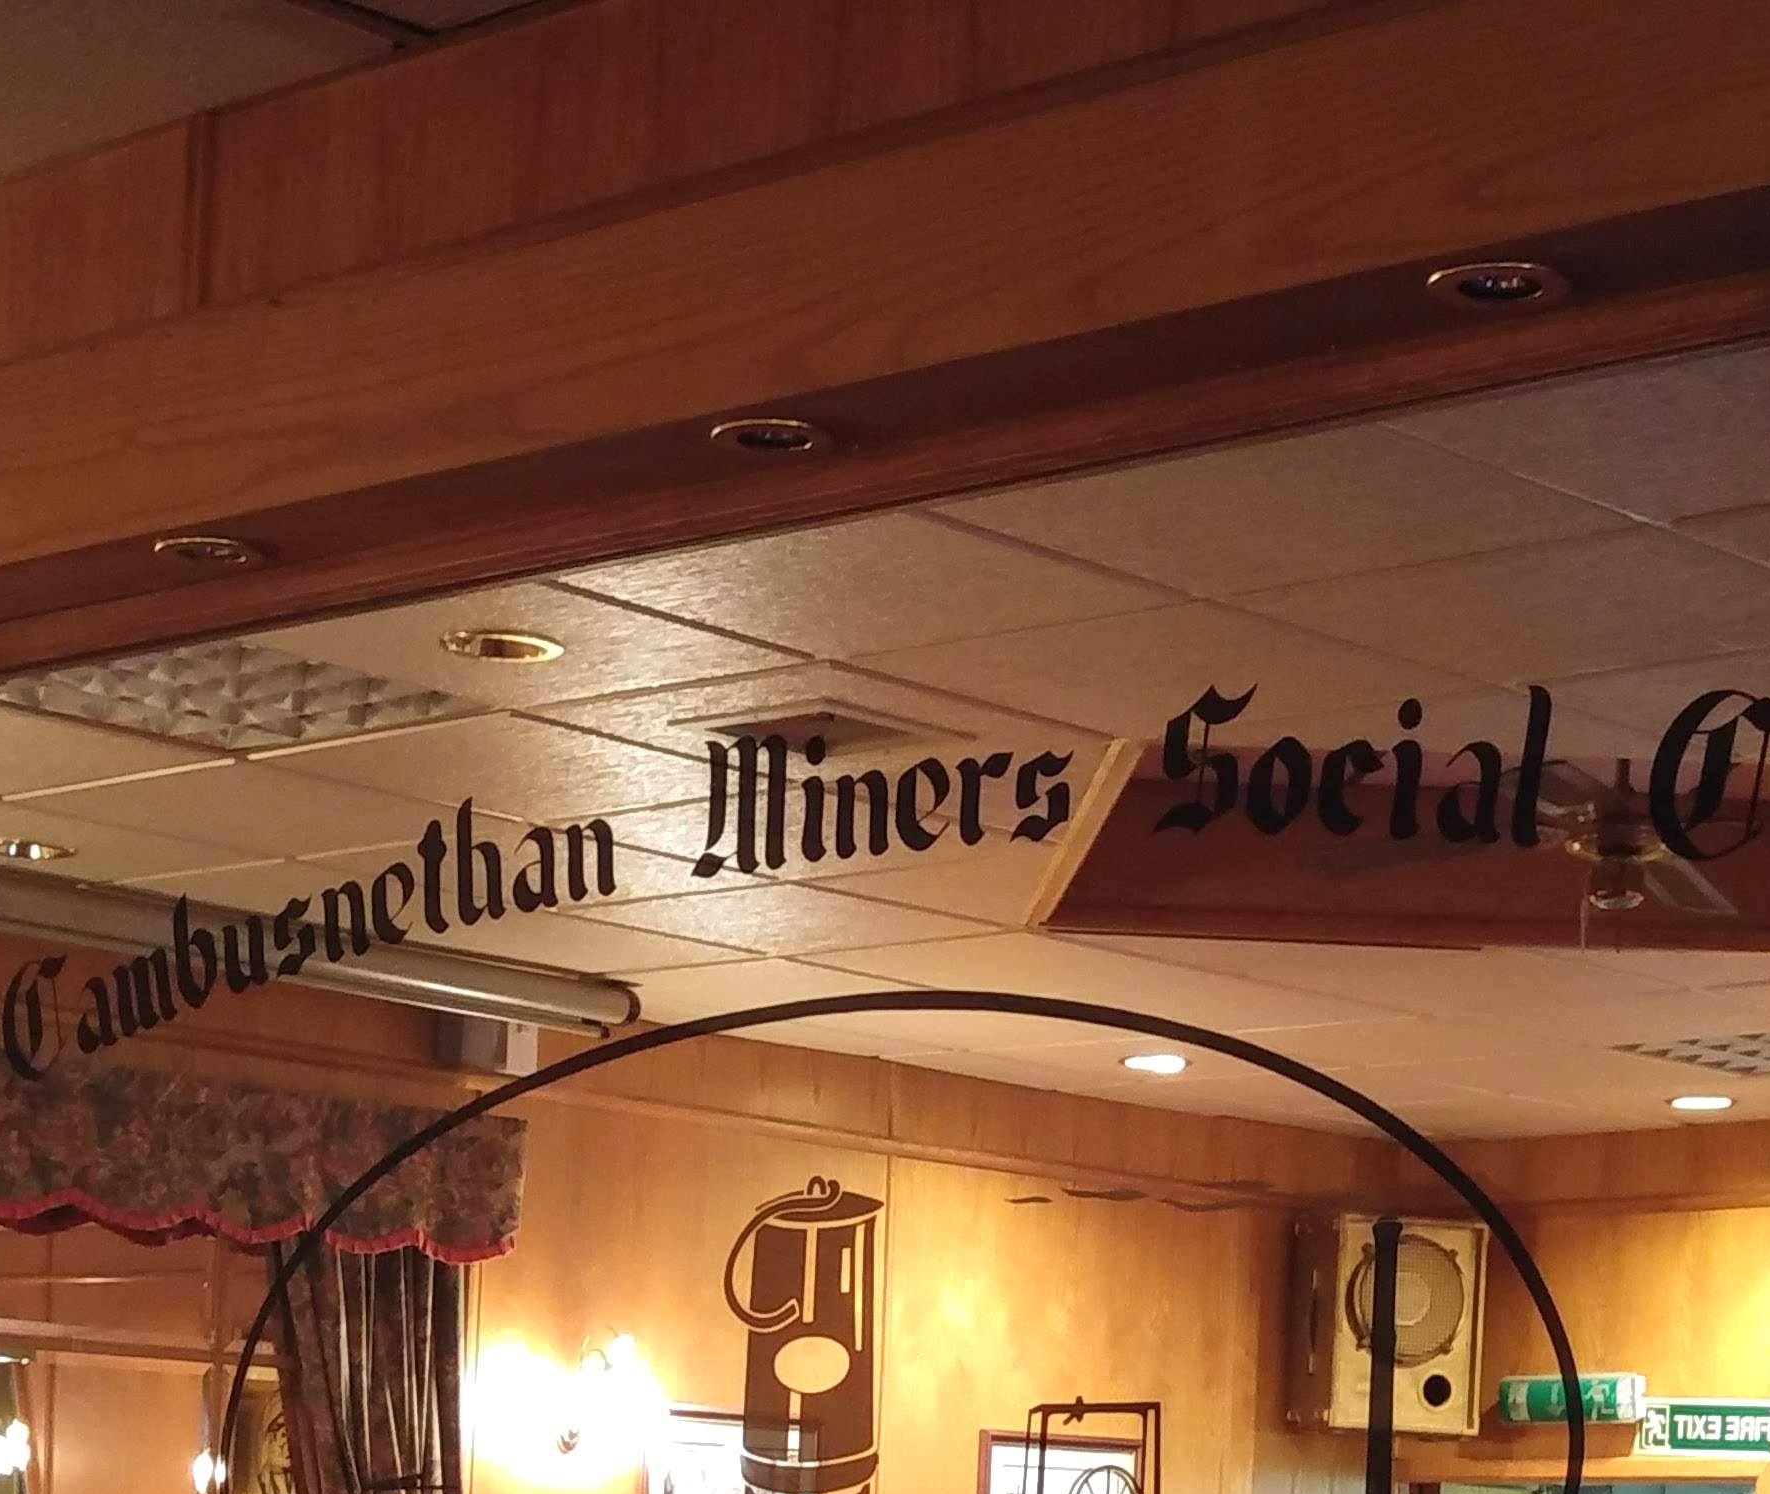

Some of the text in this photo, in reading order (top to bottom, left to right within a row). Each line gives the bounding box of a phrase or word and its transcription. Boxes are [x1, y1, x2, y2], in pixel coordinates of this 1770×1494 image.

[2, 797, 617, 1081] Cambusnethan
[691, 734, 1074, 878] Miners
[1151, 682, 1557, 849] Social
